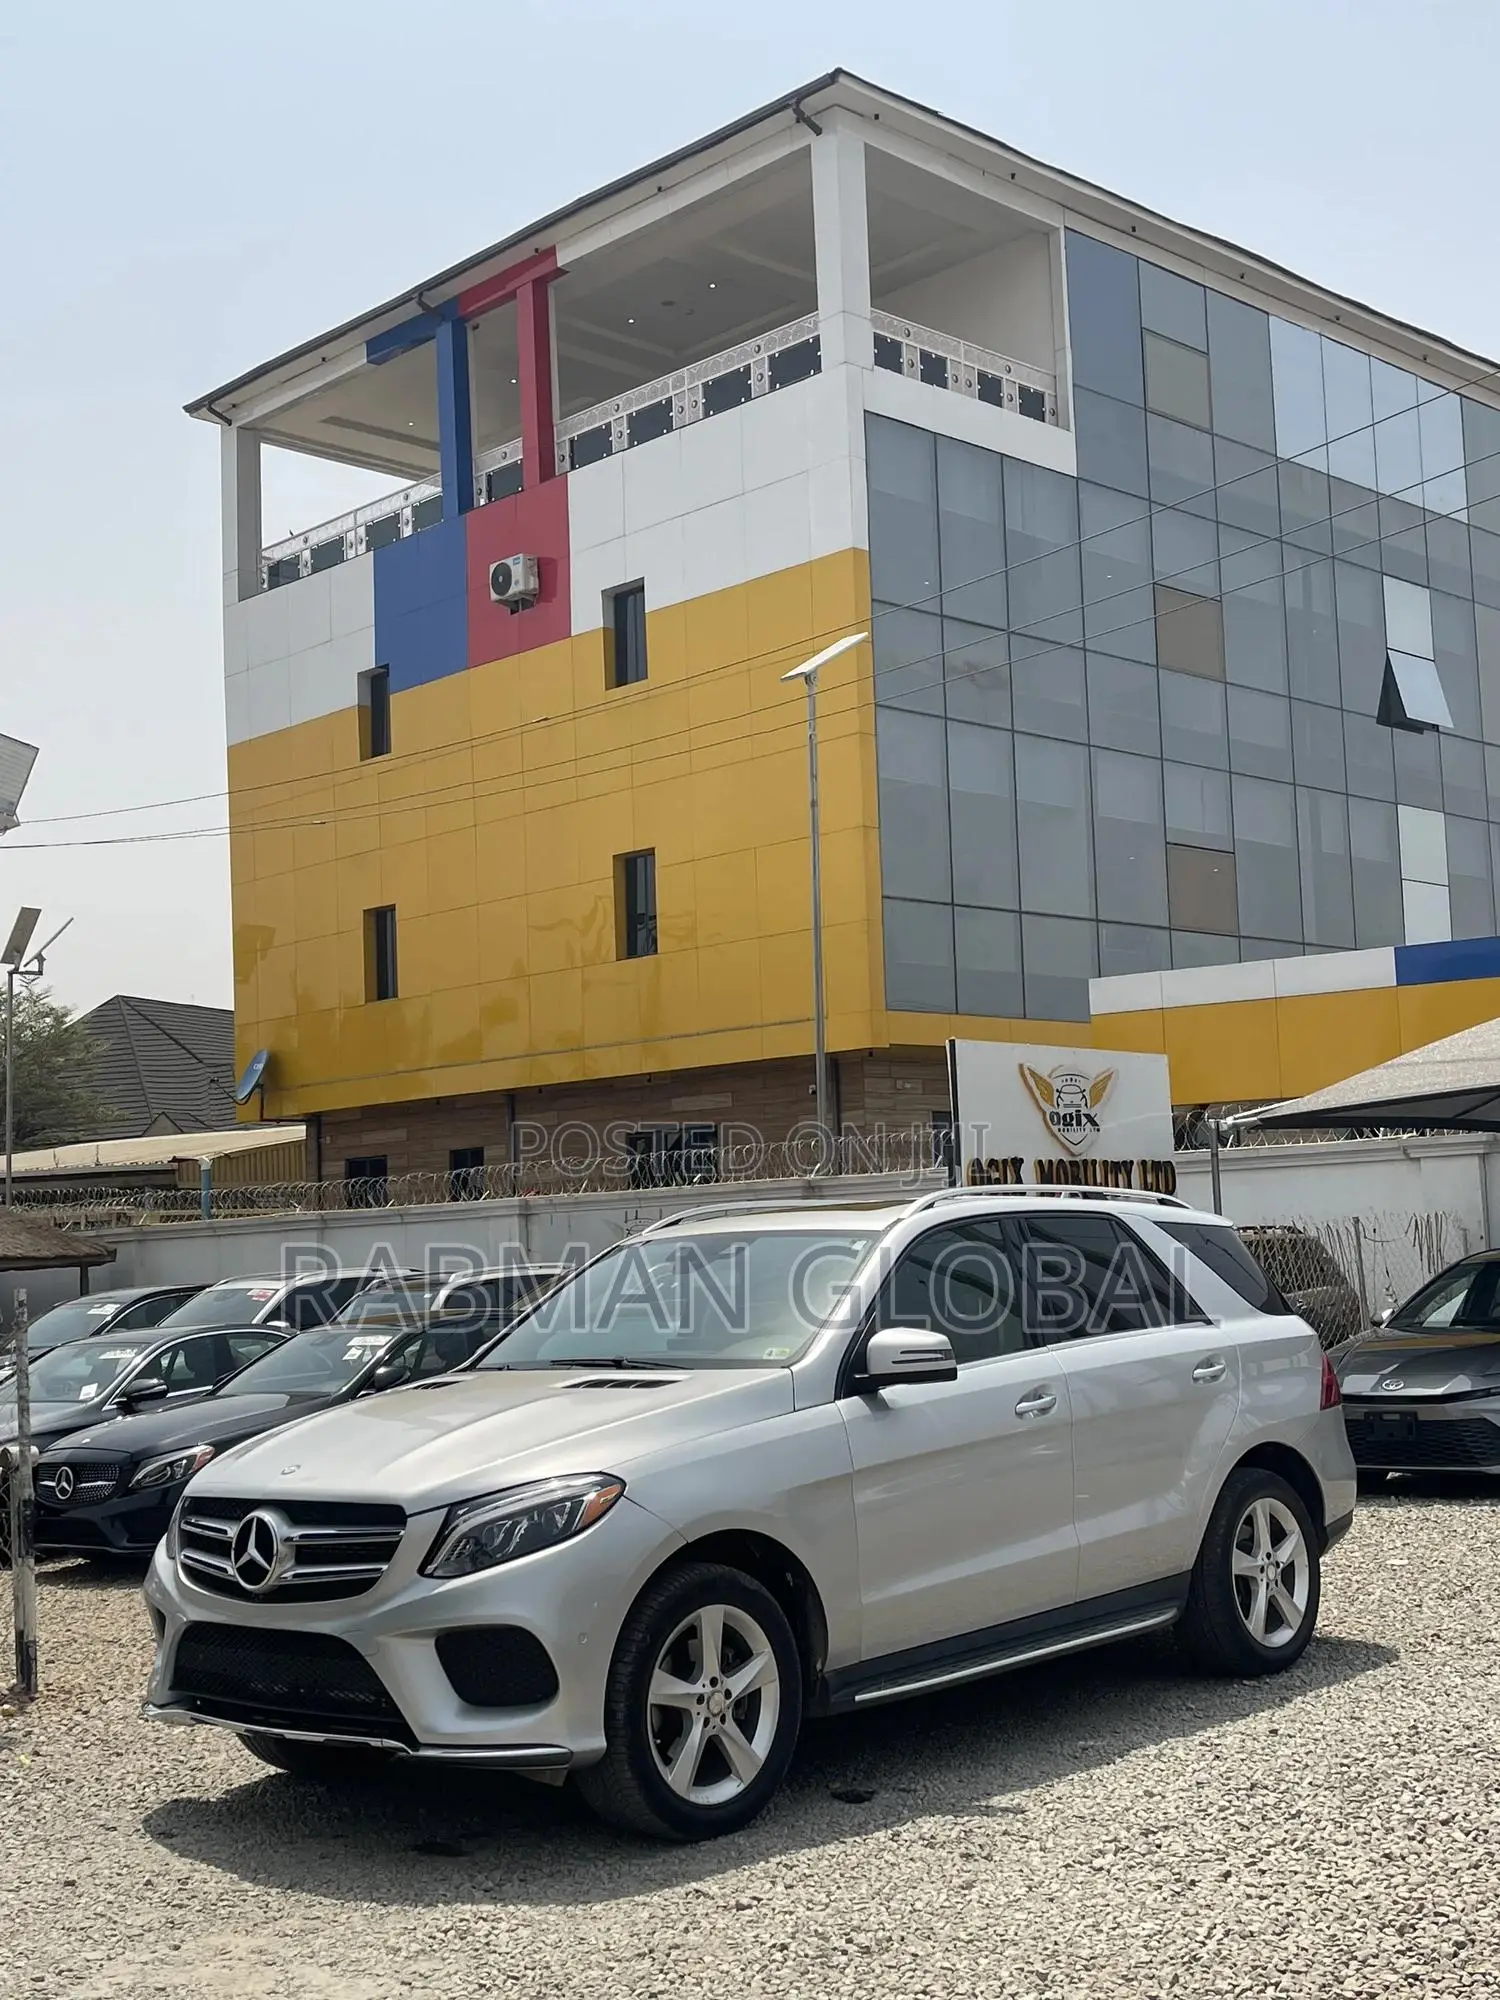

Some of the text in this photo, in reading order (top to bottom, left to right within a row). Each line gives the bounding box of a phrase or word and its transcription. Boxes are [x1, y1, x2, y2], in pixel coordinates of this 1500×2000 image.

[966, 1156, 1177, 1196] OGIX MOBILITY LTD
